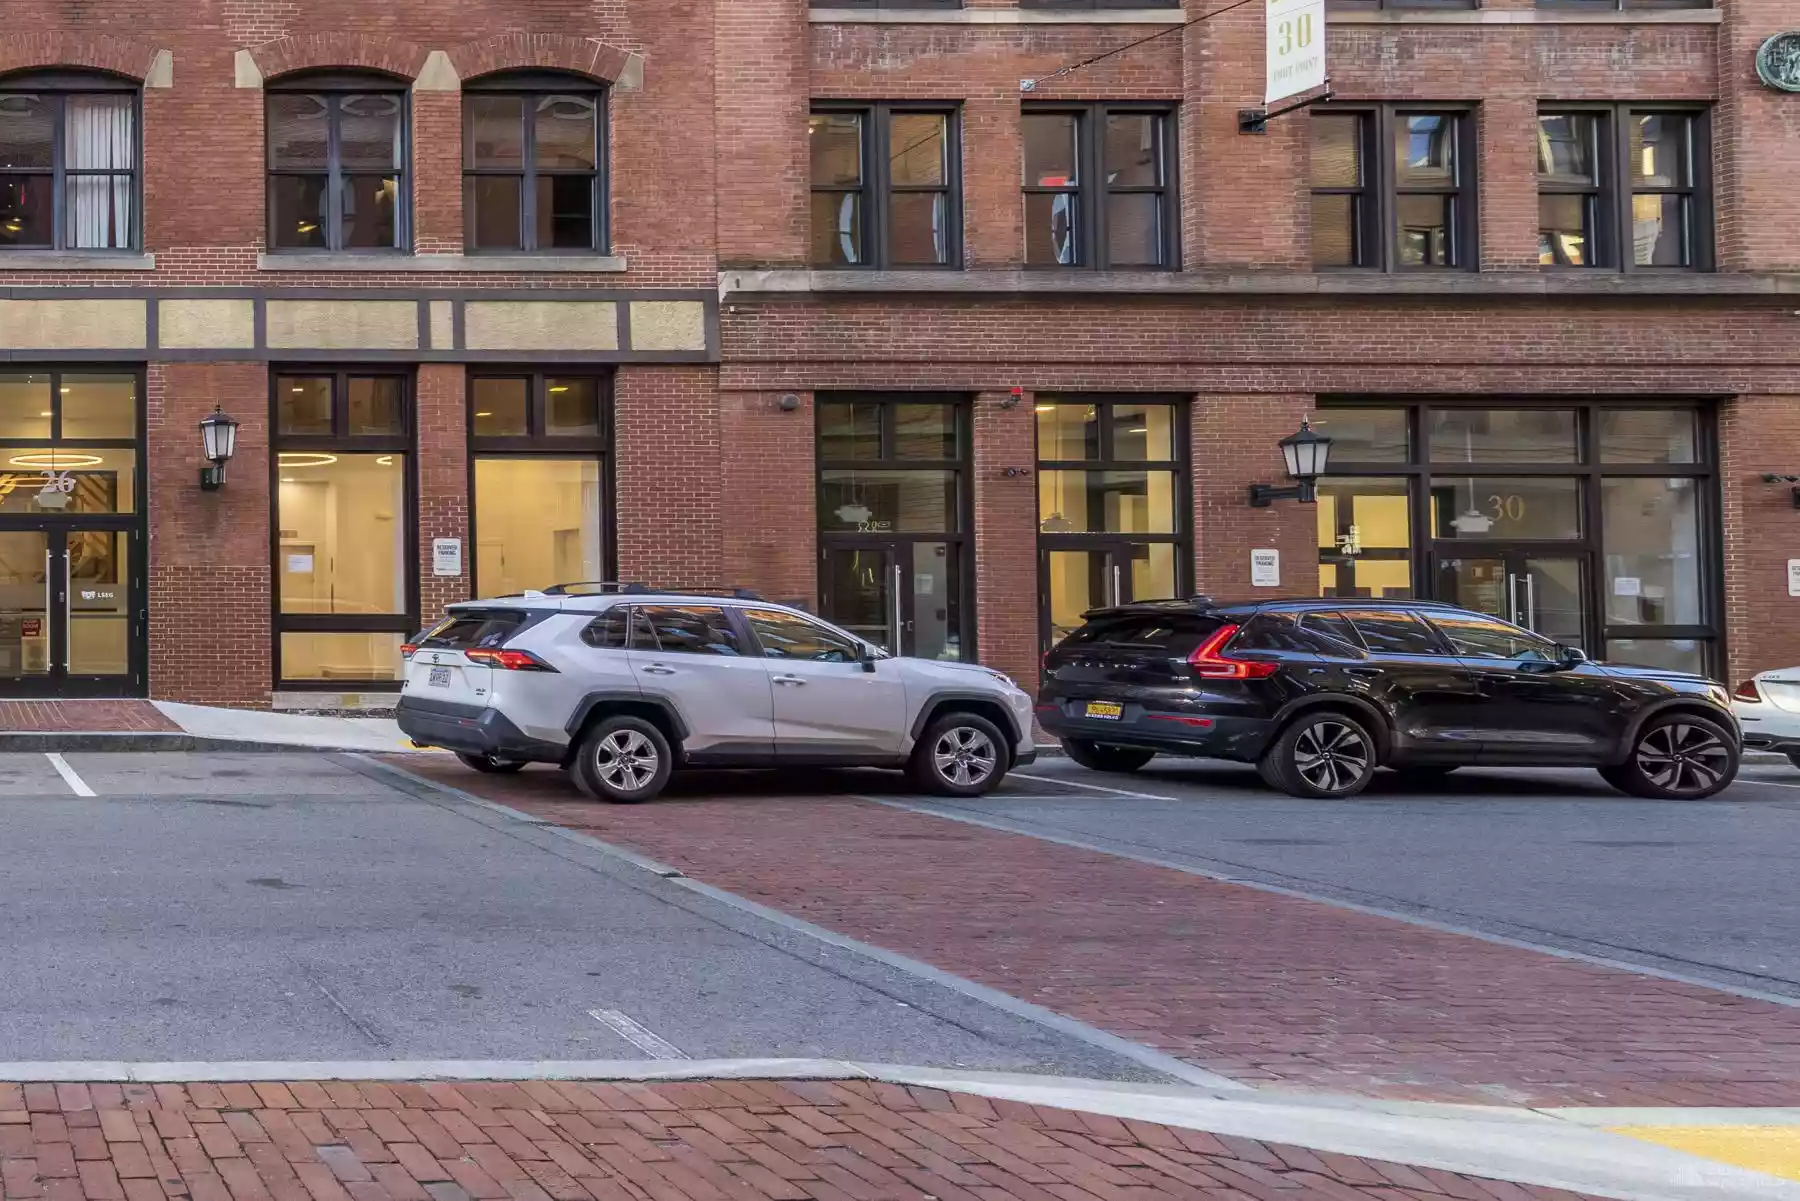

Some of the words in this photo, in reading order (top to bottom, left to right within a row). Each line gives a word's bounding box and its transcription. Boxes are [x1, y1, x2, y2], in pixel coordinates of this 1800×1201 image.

[1278, 13, 1312, 56] 30
[40, 469, 77, 493] 26
[1488, 494, 1525, 521] 30
